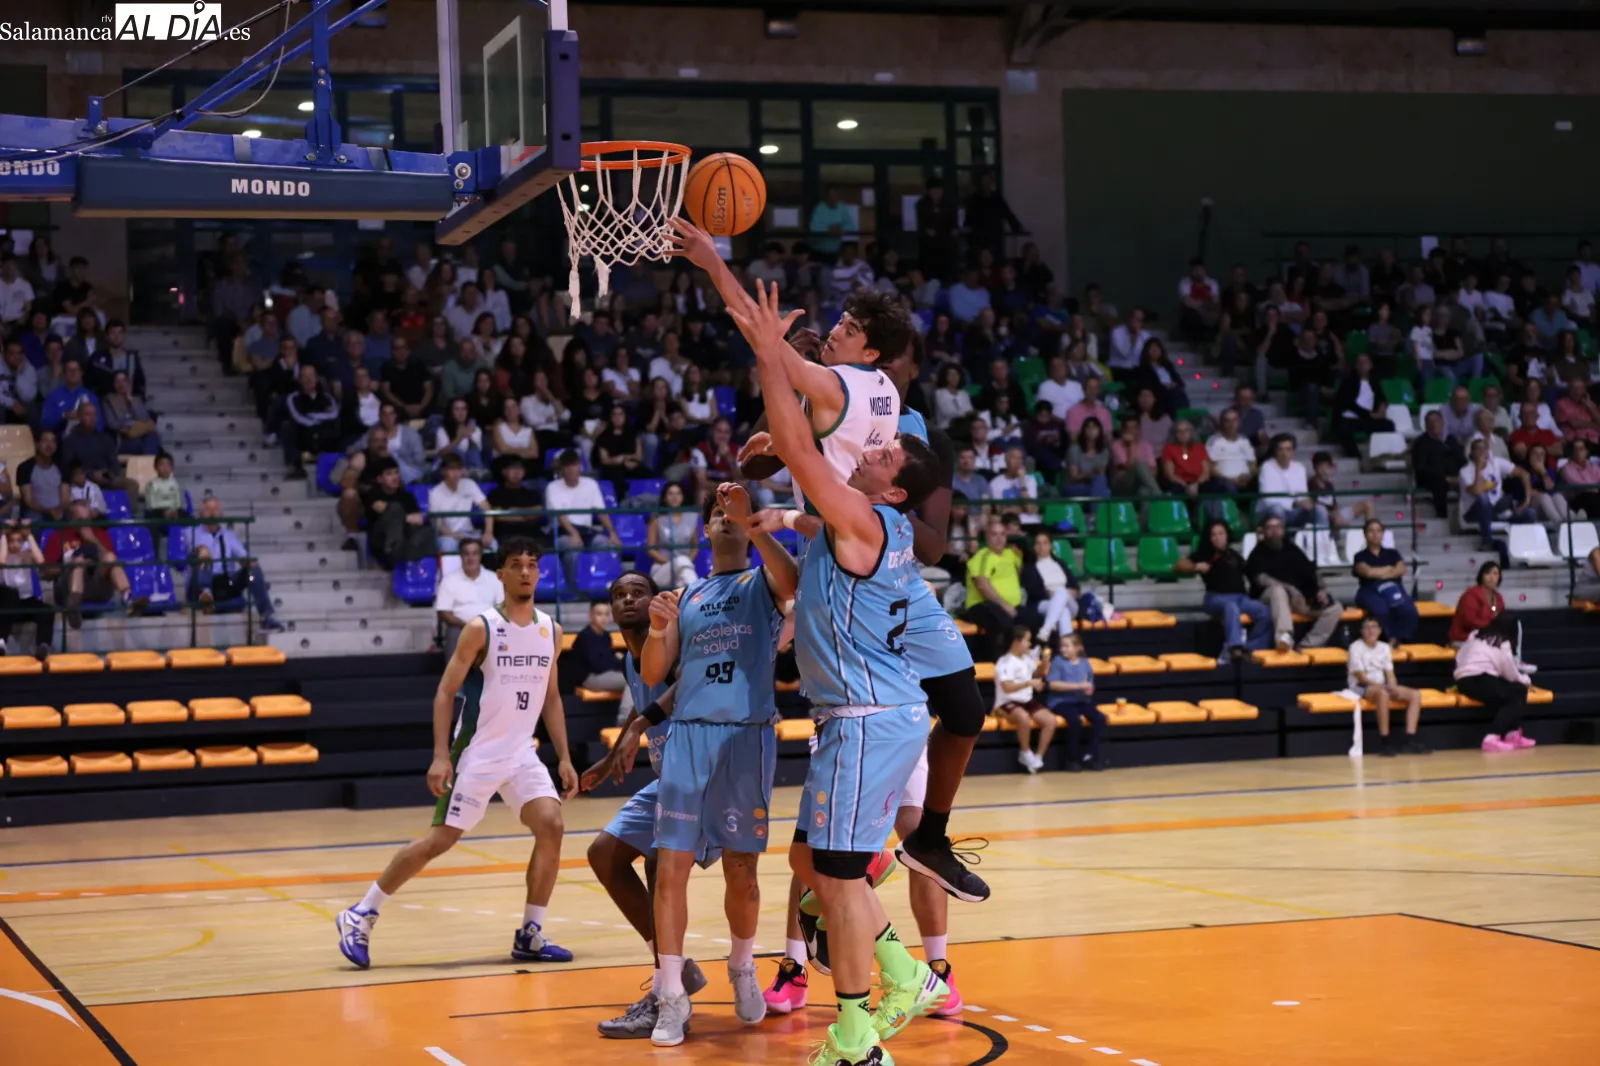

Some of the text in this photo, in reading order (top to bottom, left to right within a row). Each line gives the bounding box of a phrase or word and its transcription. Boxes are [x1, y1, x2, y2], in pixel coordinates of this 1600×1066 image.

[231, 178, 310, 197] MONDO
[869, 396, 892, 416] MIGUEL
[691, 622, 752, 644] recoletas
[886, 597, 910, 655] 2
[703, 636, 740, 655] salud
[705, 660, 736, 685] 99
[516, 691, 530, 710] 19
